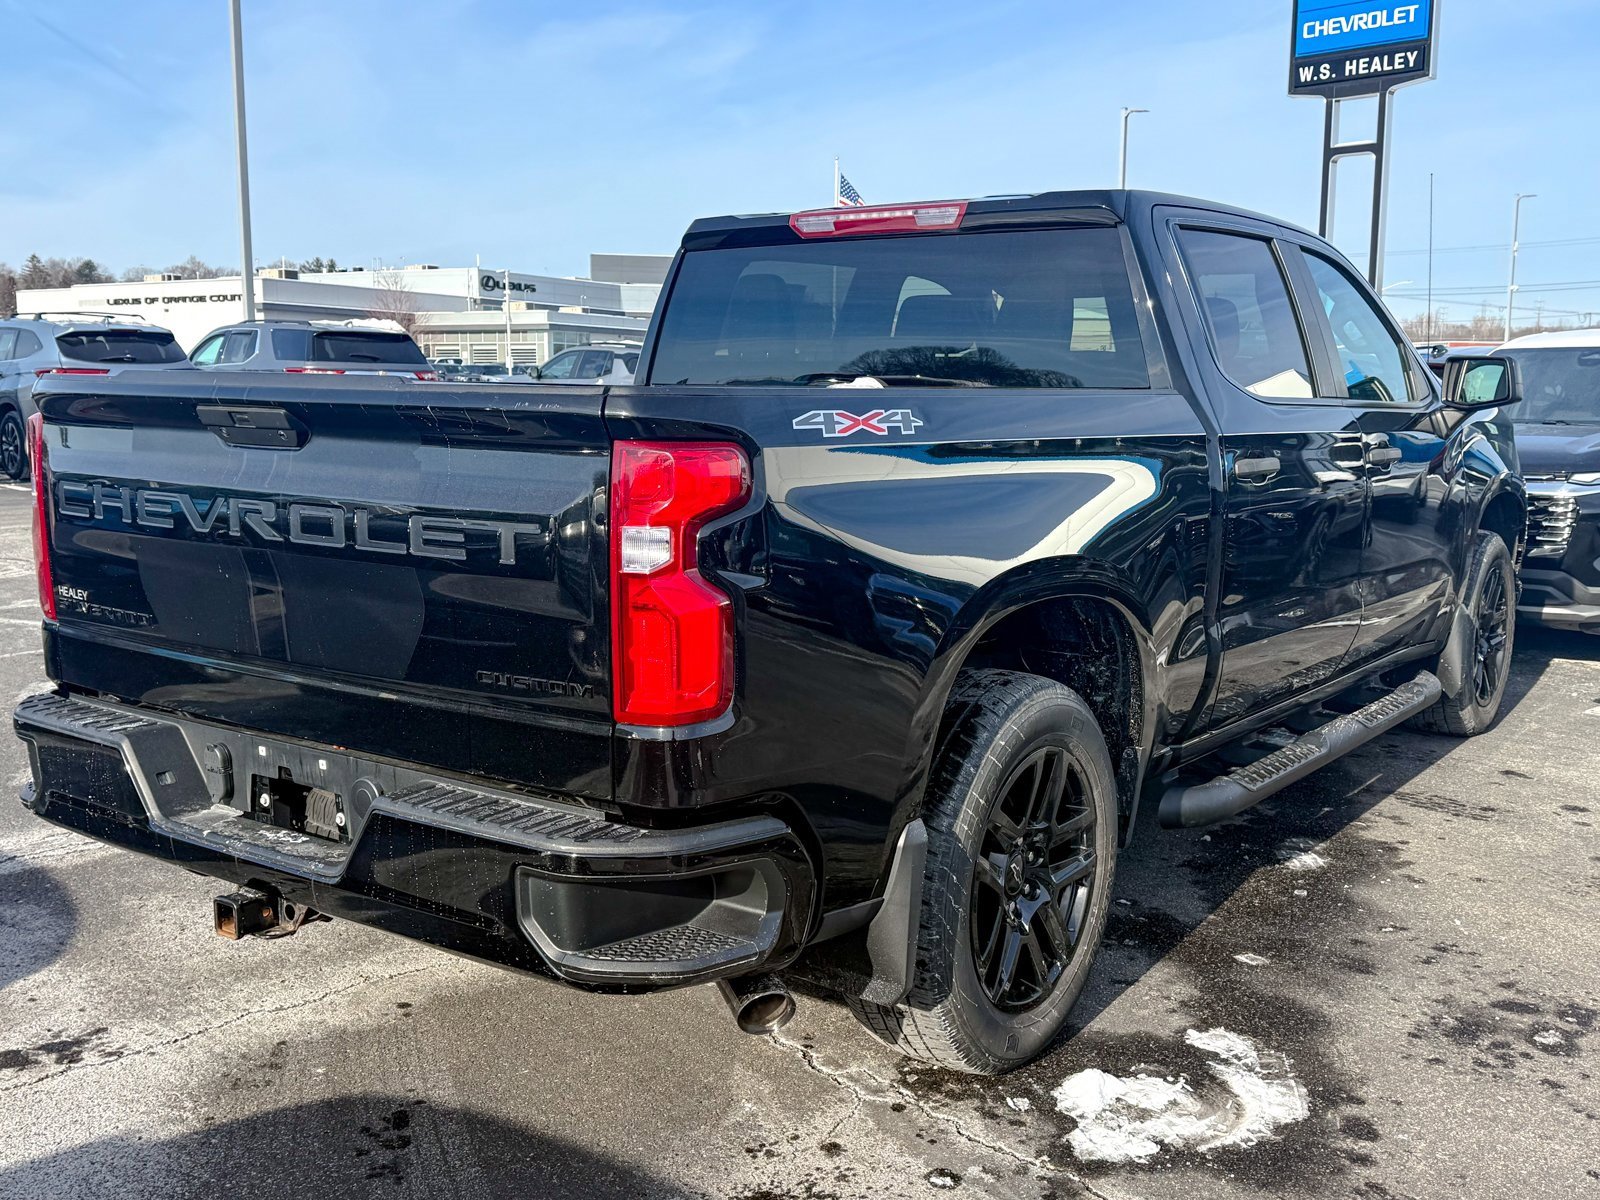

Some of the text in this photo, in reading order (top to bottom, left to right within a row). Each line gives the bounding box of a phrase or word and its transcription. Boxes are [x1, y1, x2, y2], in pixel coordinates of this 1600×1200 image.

[1302, 5, 1419, 39] CHEVROLET
[1299, 50, 1418, 82] W.S. HEALEY
[106, 298, 142, 306] LEXUS
[144, 297, 159, 305] OF
[162, 295, 207, 304] ORANGE
[58, 480, 541, 565] CHEVROLET
[58, 585, 88, 600] HEALEY
[477, 670, 595, 699] CUSTOM
